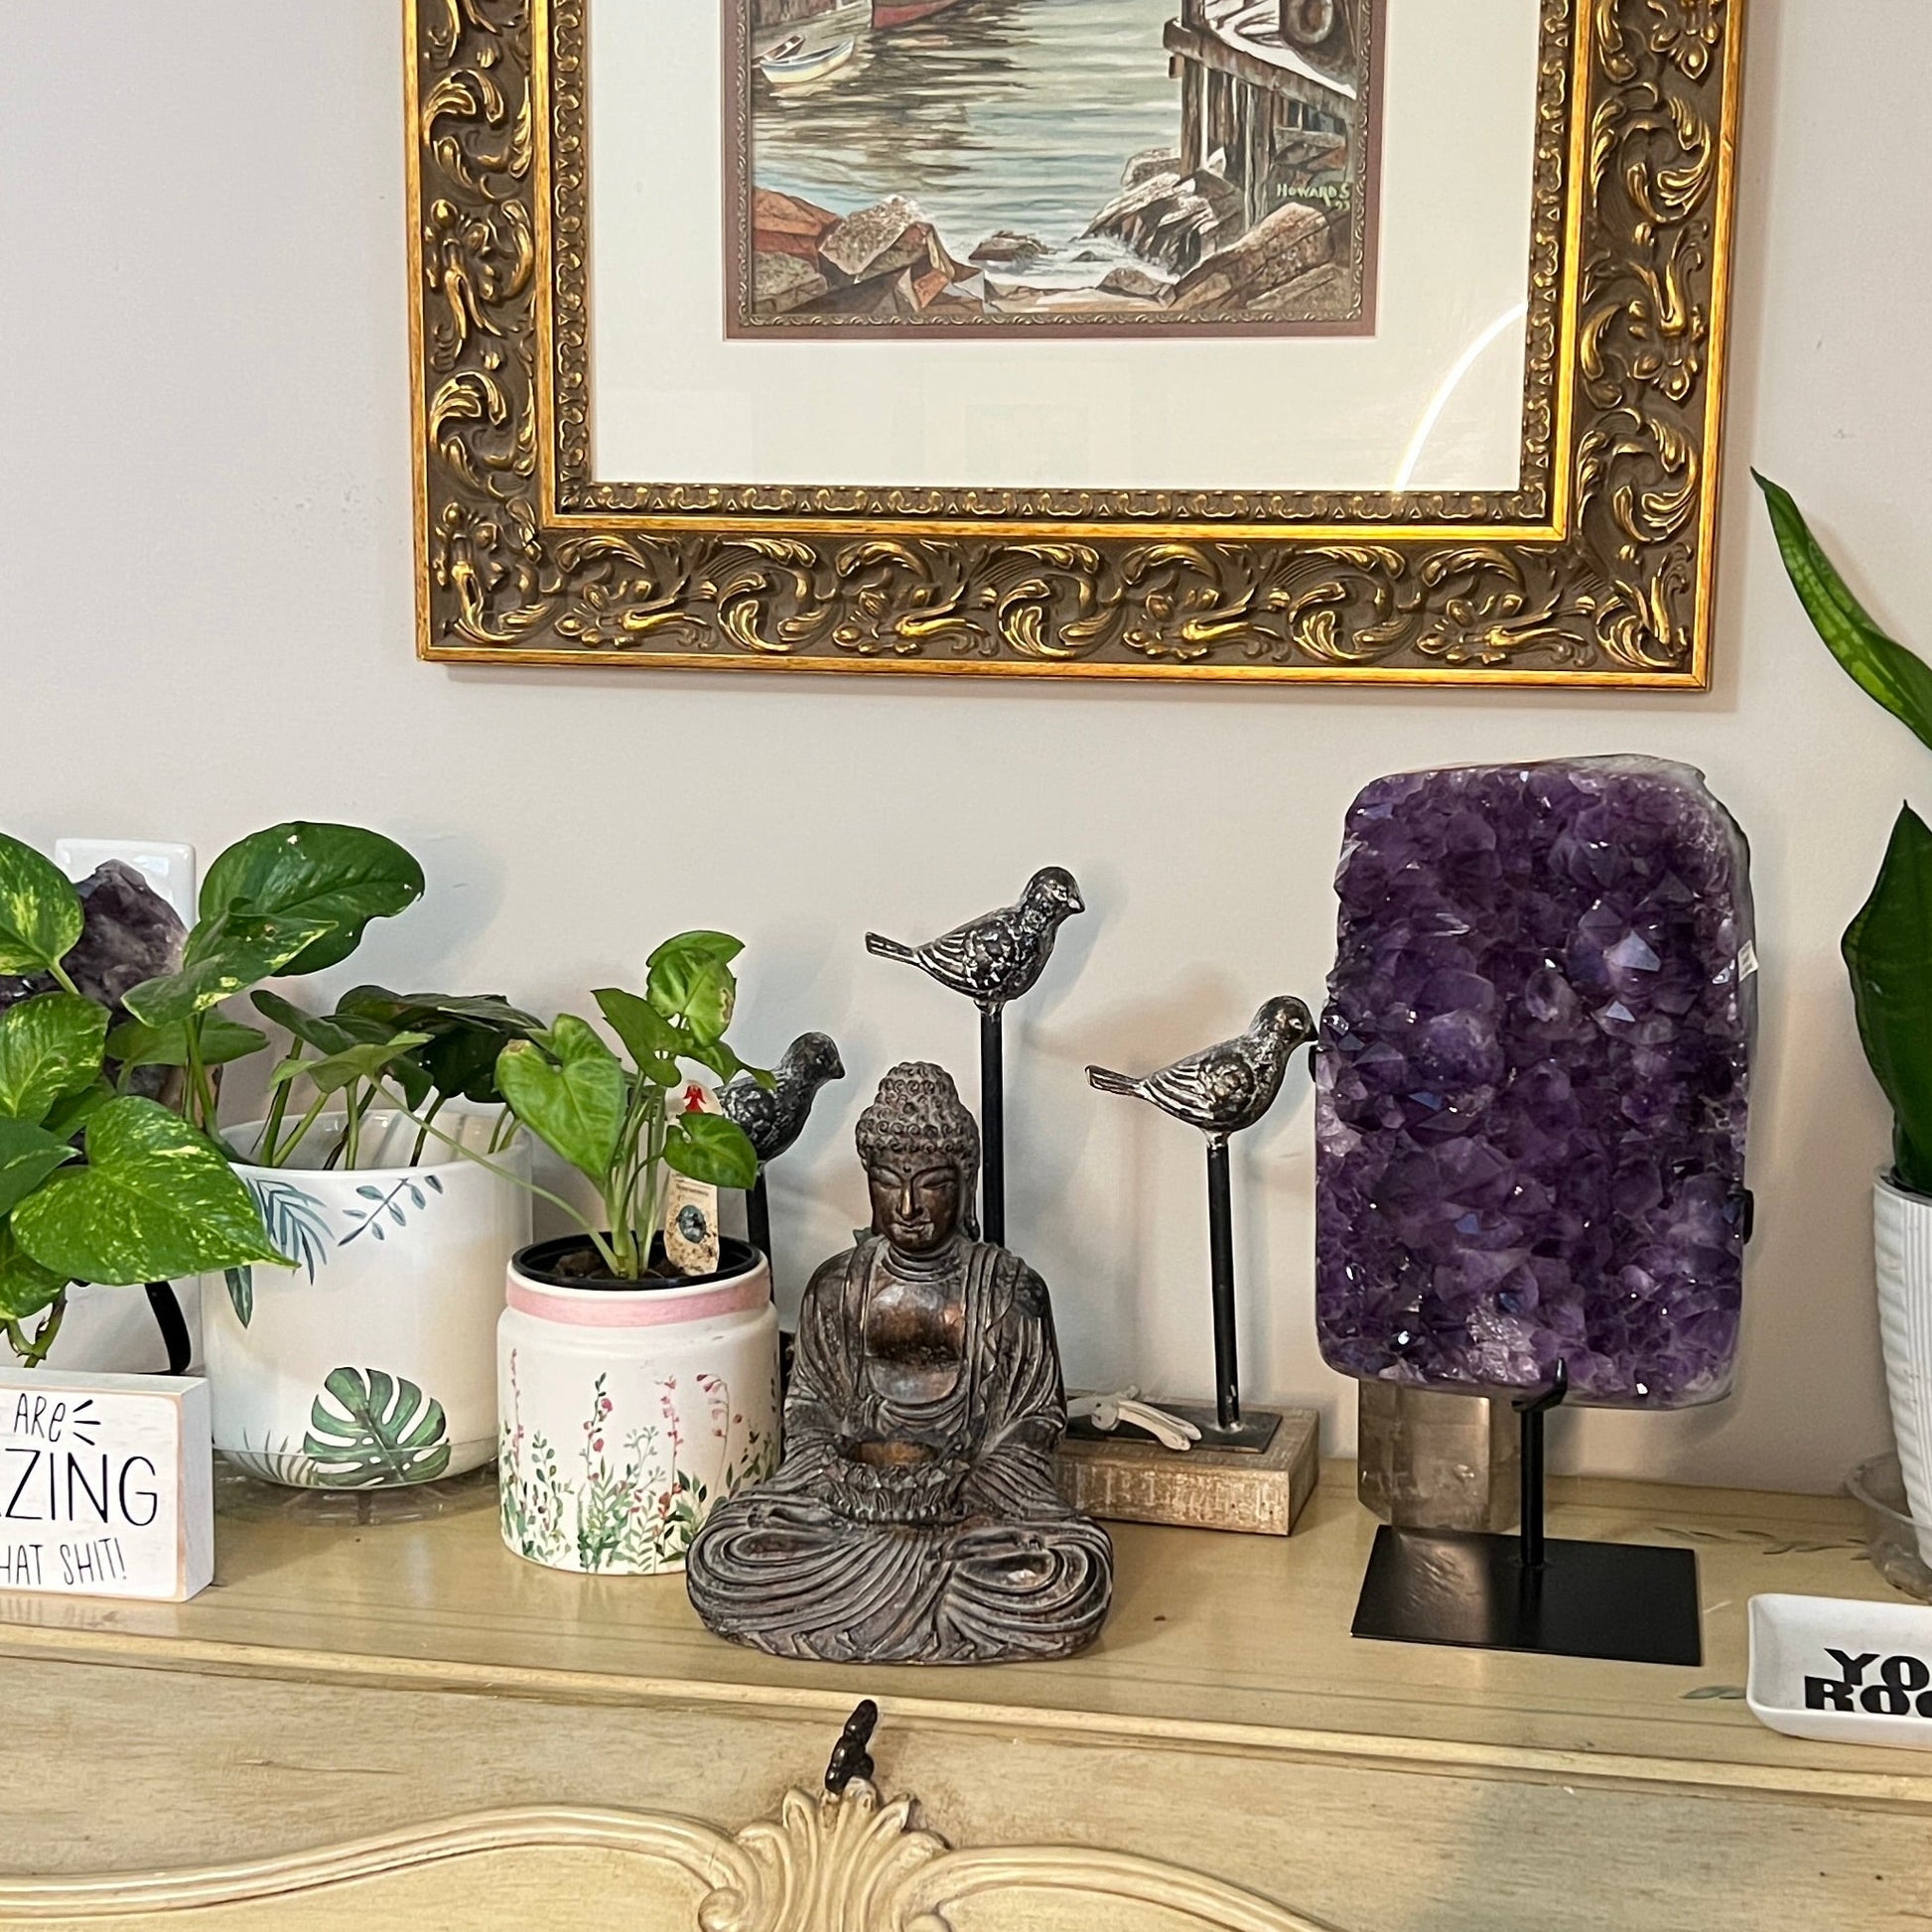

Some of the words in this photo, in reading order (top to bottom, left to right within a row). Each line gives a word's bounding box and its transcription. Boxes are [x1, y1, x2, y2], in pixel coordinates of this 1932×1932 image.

[0, 1448, 158, 1527] ZING
[60, 1537, 127, 1586] SHIT!
[1824, 1647, 1930, 1692] YO
